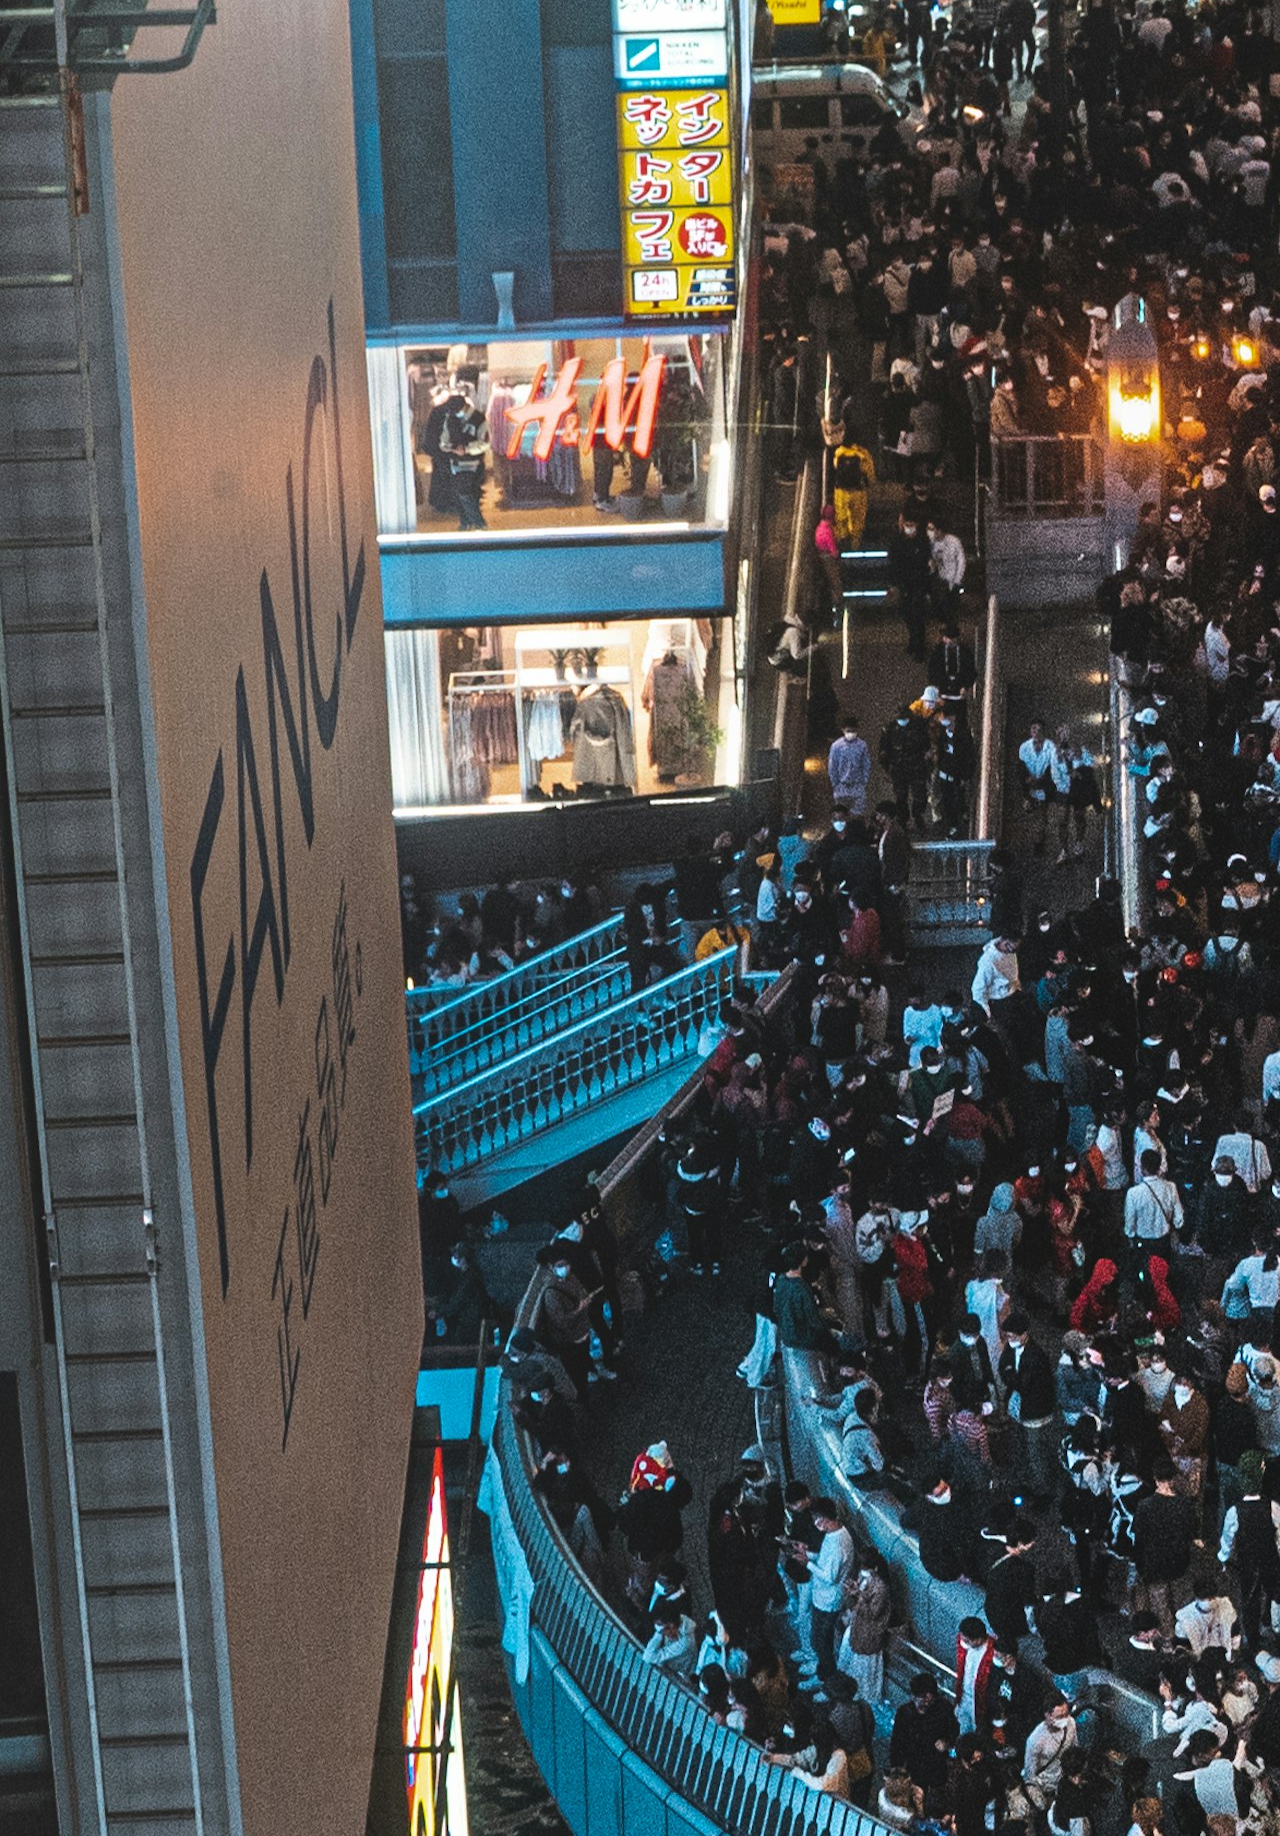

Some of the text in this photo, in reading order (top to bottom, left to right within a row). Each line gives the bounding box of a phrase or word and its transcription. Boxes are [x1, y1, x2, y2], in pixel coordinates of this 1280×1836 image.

[691, 295, 728, 305] しっかり
[505, 350, 669, 462] H&M
[190, 296, 366, 1301] FANCL
